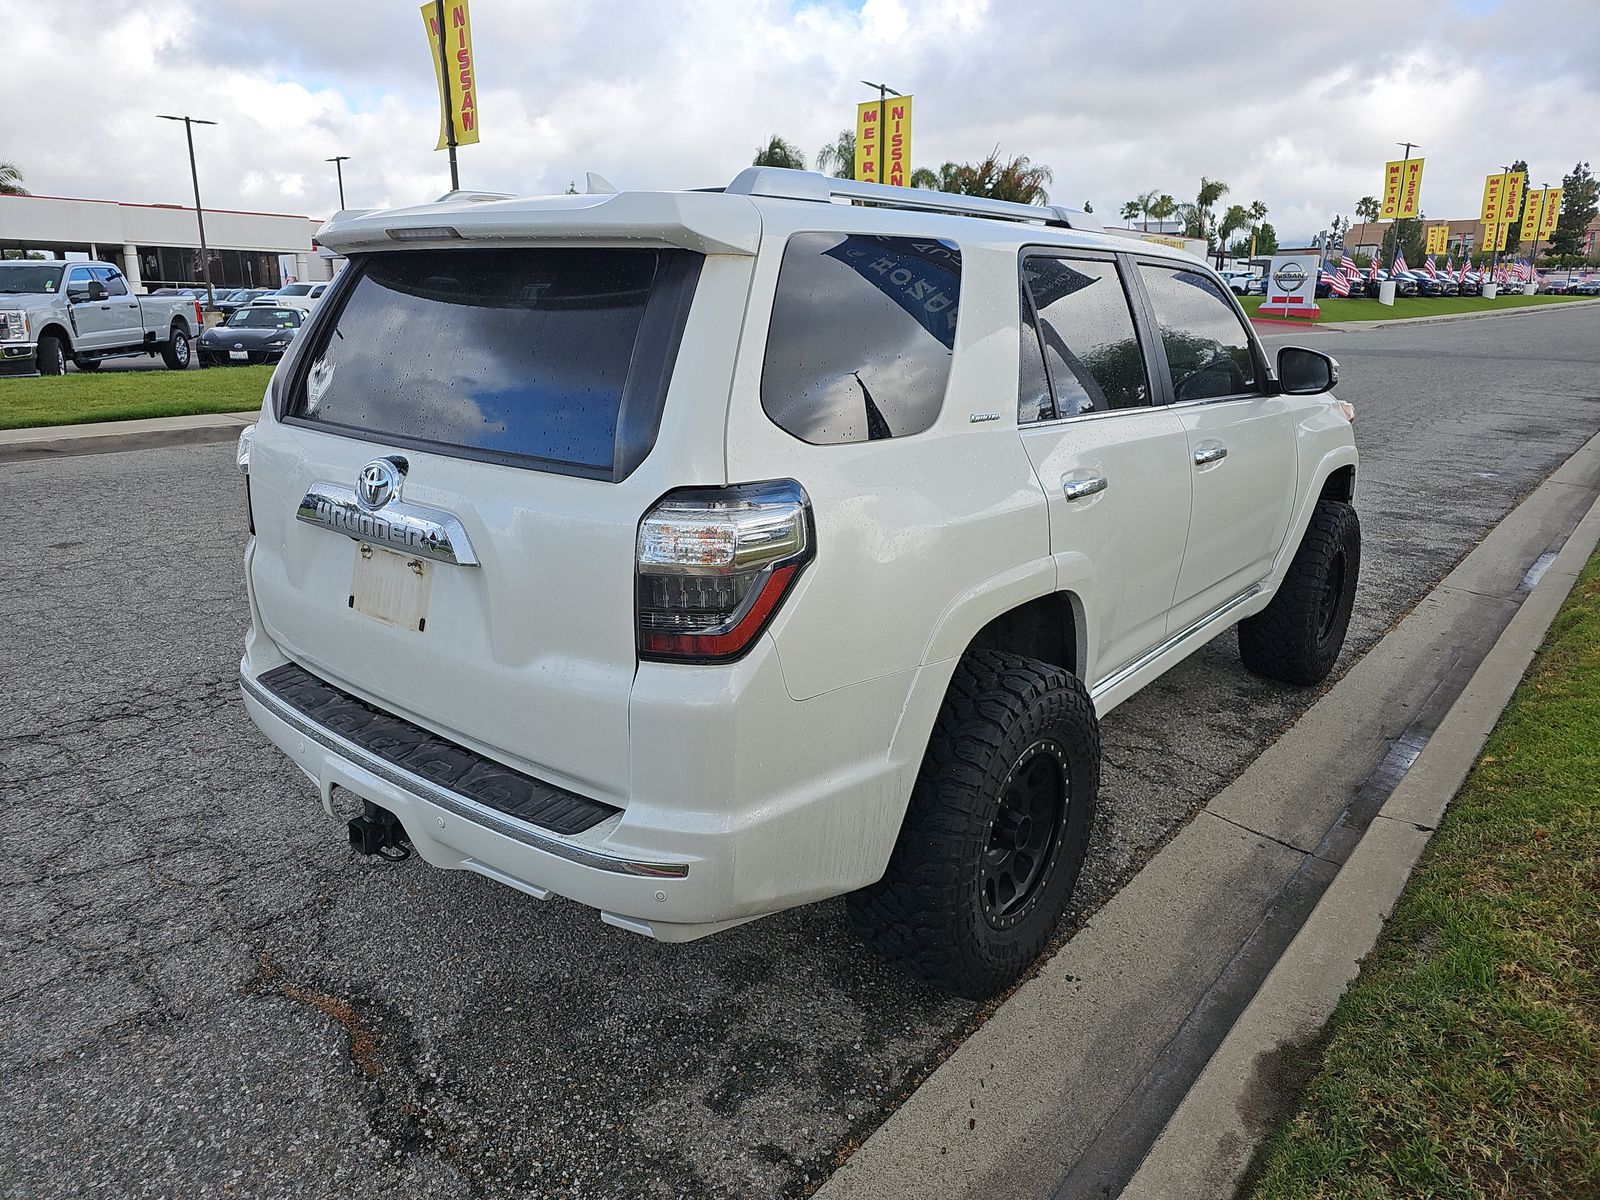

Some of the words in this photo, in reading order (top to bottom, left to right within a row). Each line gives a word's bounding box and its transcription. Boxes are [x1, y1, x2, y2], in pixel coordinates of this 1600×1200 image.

[453, 5, 474, 131] NISSAN
[863, 110, 877, 182] METR
[891, 106, 904, 186] NISSAN
[1385, 166, 1399, 213] METRO
[1404, 164, 1418, 212] NISSAN
[1485, 179, 1500, 219] METRO
[1505, 177, 1519, 218] NISSAN
[1526, 193, 1539, 228] METRO
[1545, 192, 1558, 227] NISSAN
